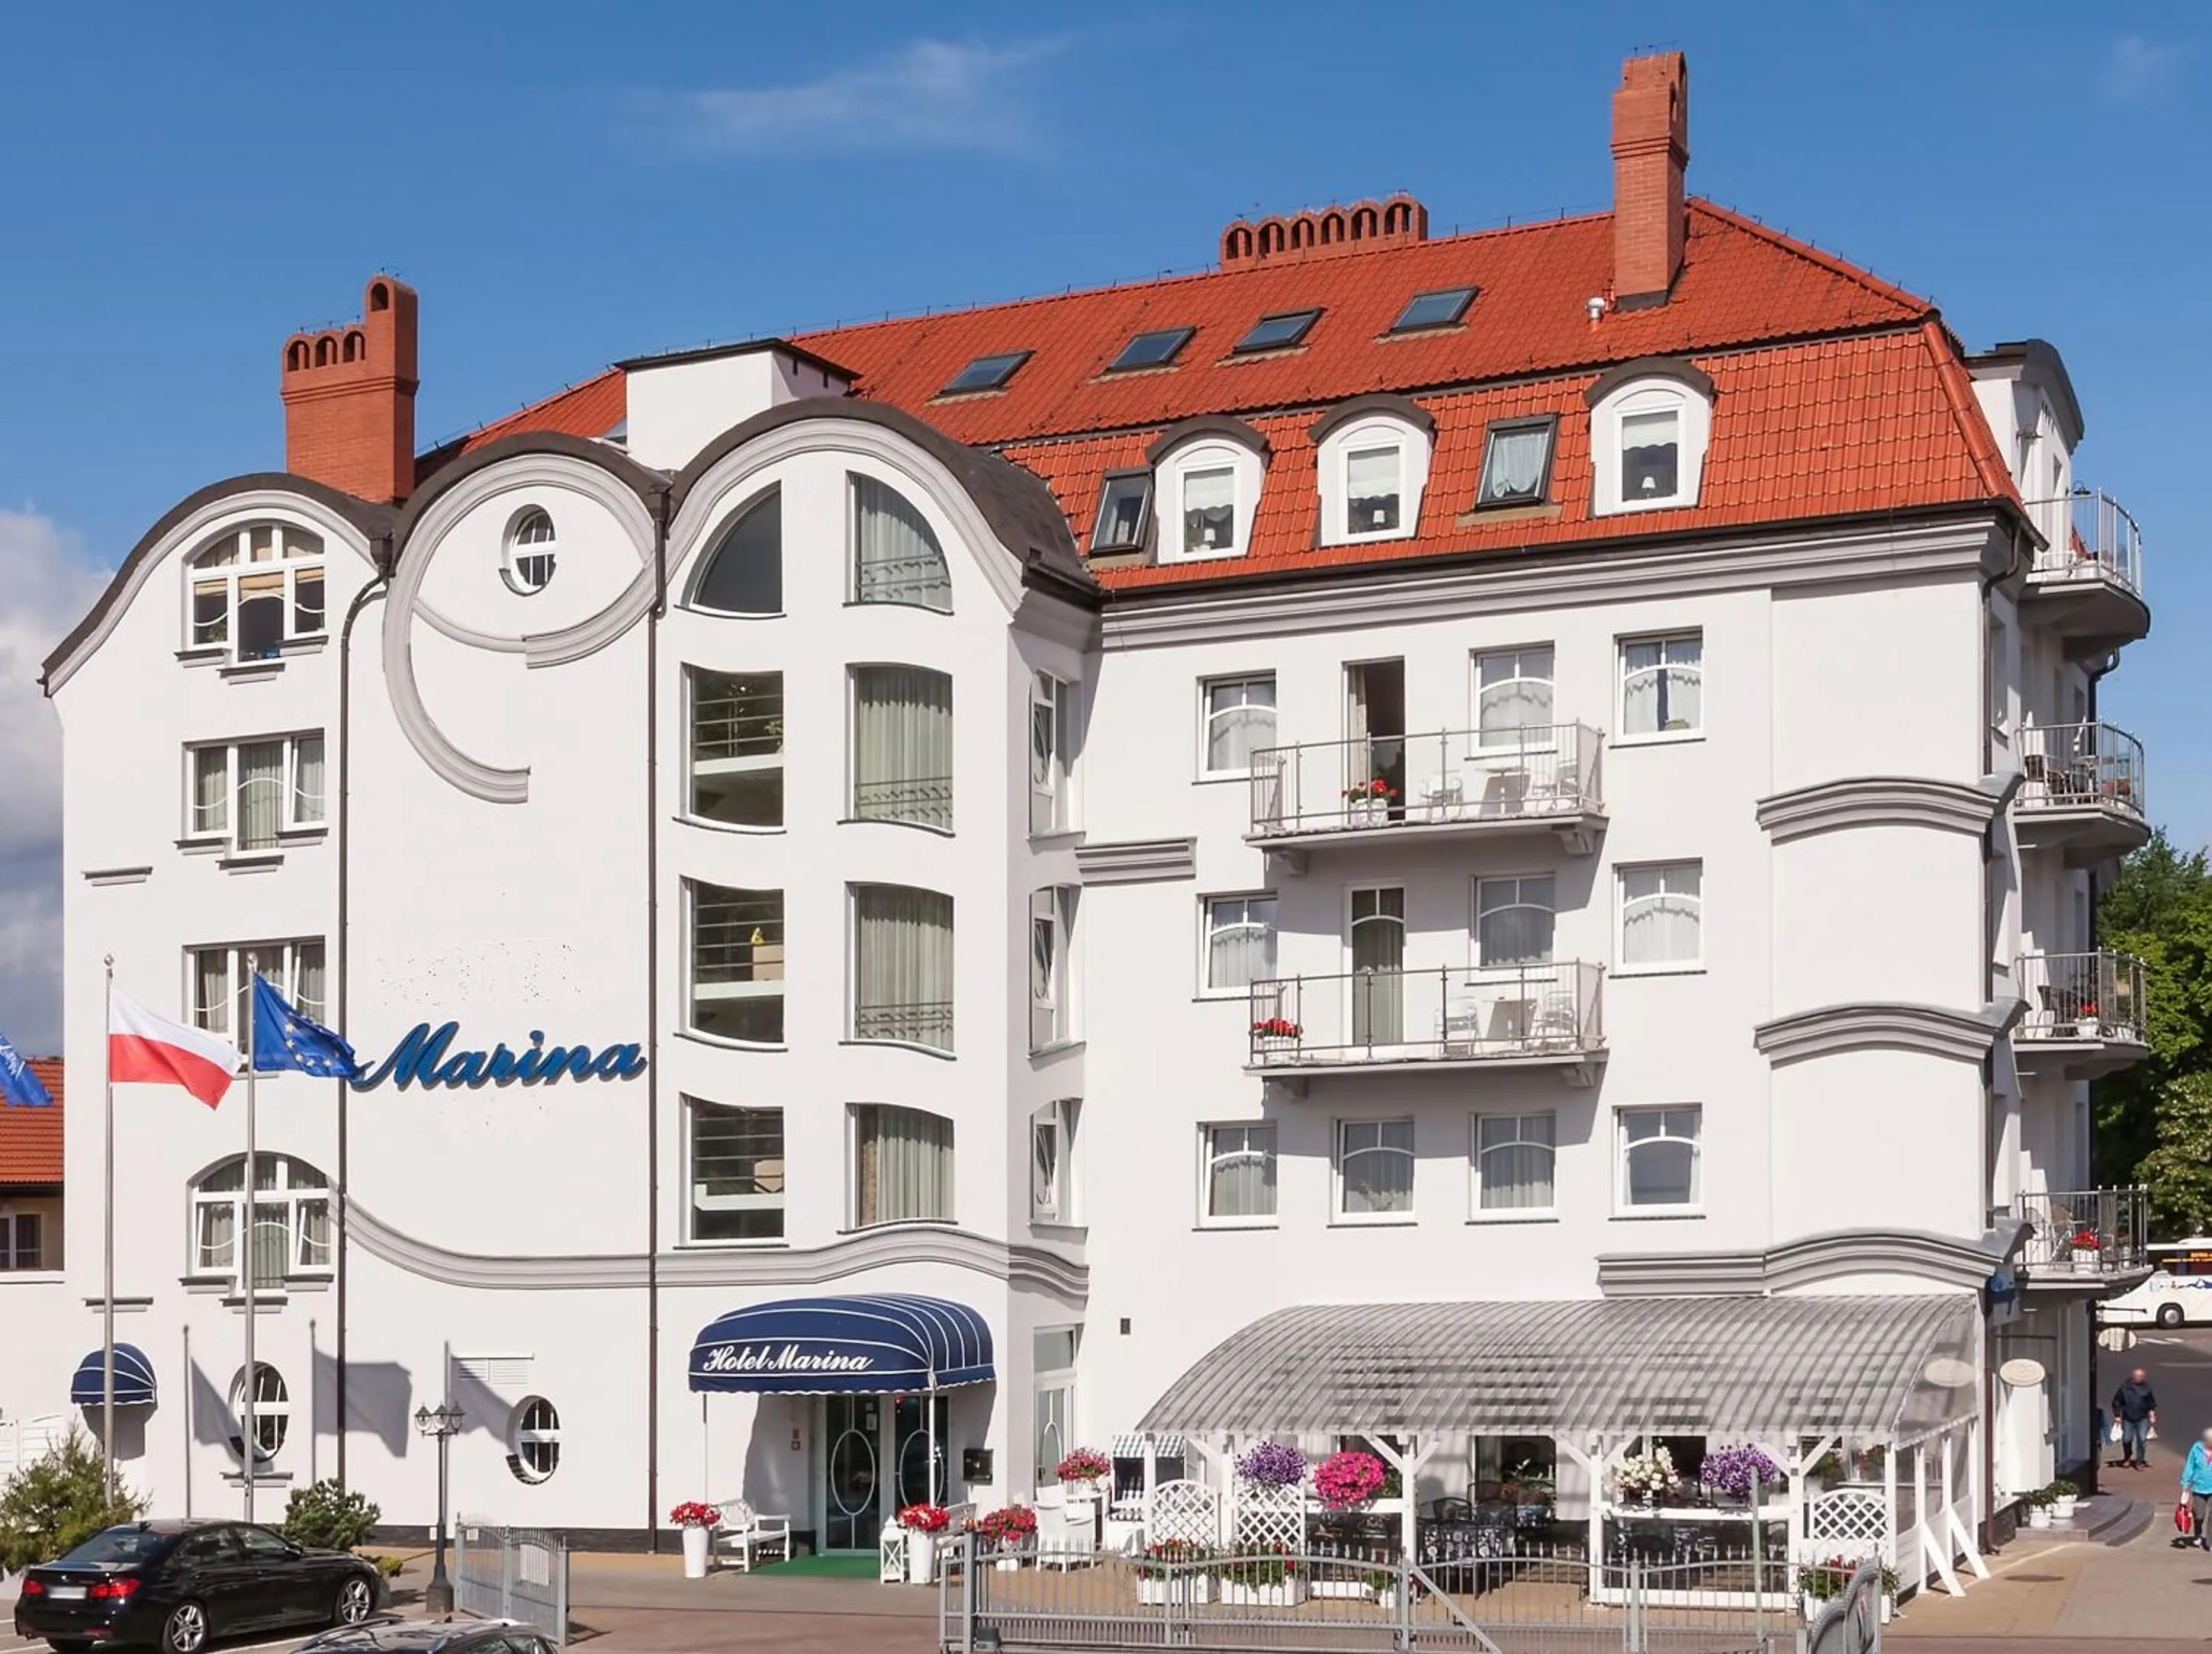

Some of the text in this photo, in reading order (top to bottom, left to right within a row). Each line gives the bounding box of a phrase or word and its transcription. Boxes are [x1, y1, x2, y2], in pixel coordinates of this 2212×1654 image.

[349, 1022, 647, 1090] Marina
[703, 1344, 873, 1371] Hotel Marina
